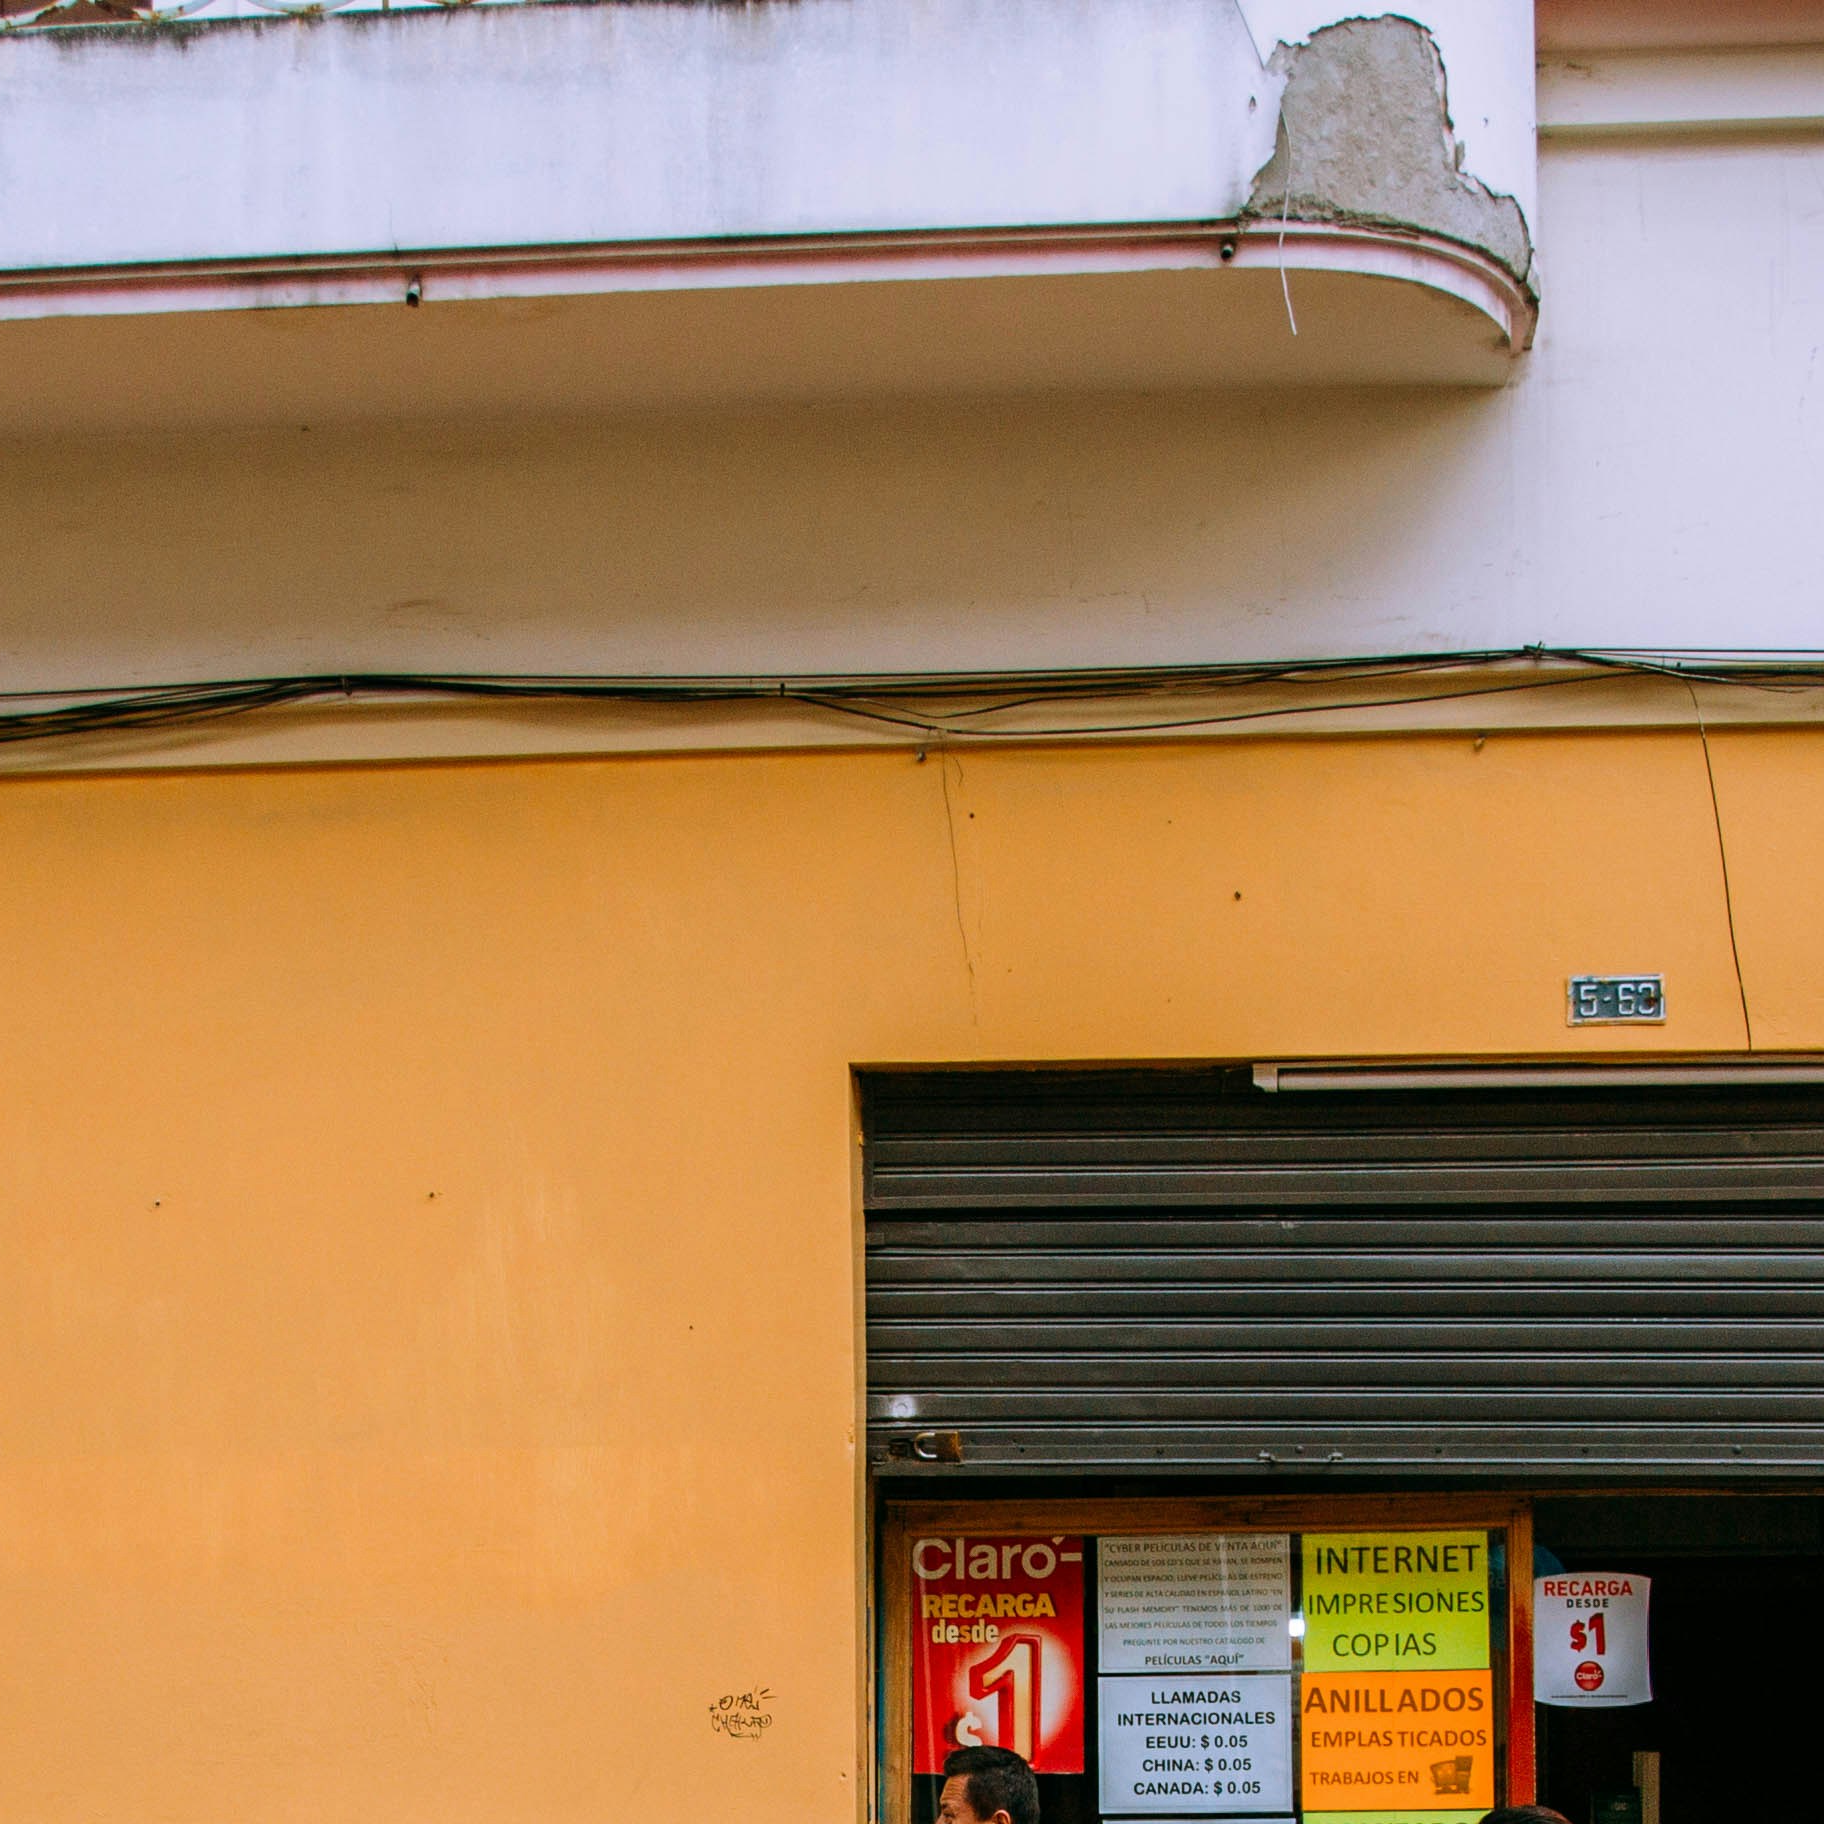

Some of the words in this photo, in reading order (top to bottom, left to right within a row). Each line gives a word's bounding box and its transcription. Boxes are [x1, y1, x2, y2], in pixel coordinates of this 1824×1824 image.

[1316, 1545, 1480, 1574] INTERNET
[1544, 1580, 1632, 1596] RECARGA
[922, 1593, 1056, 1618] RECARGA
[1308, 1591, 1484, 1615] IMPRESIONES
[1566, 1598, 1609, 1608] DESDE
[932, 1619, 999, 1643] desde
[1570, 1612, 1606, 1656] $1
[1333, 1633, 1436, 1657] COPIAS
[1145, 1653, 1201, 1665] PELÍCULAS
[1151, 1691, 1241, 1704] LLAMADAS
[1304, 1687, 1484, 1713] ANILLADOS
[1118, 1712, 1275, 1726] INTERNACIONALES
[1146, 1736, 1196, 1749] EEUU:
[1200, 1735, 1210, 1750] $
[1214, 1735, 1248, 1748] 0.05
[1142, 1759, 1199, 1772] CHINA:
[1204, 1758, 1213, 1773] $
[1218, 1758, 1252, 1771] 0.05
[1310, 1771, 1394, 1785] TRABAJOS
[1398, 1771, 1419, 1784] EN
[1134, 1782, 1209, 1795] CANADA:
[1214, 1781, 1222, 1797] $
[1227, 1781, 1261, 1794] 0.05
